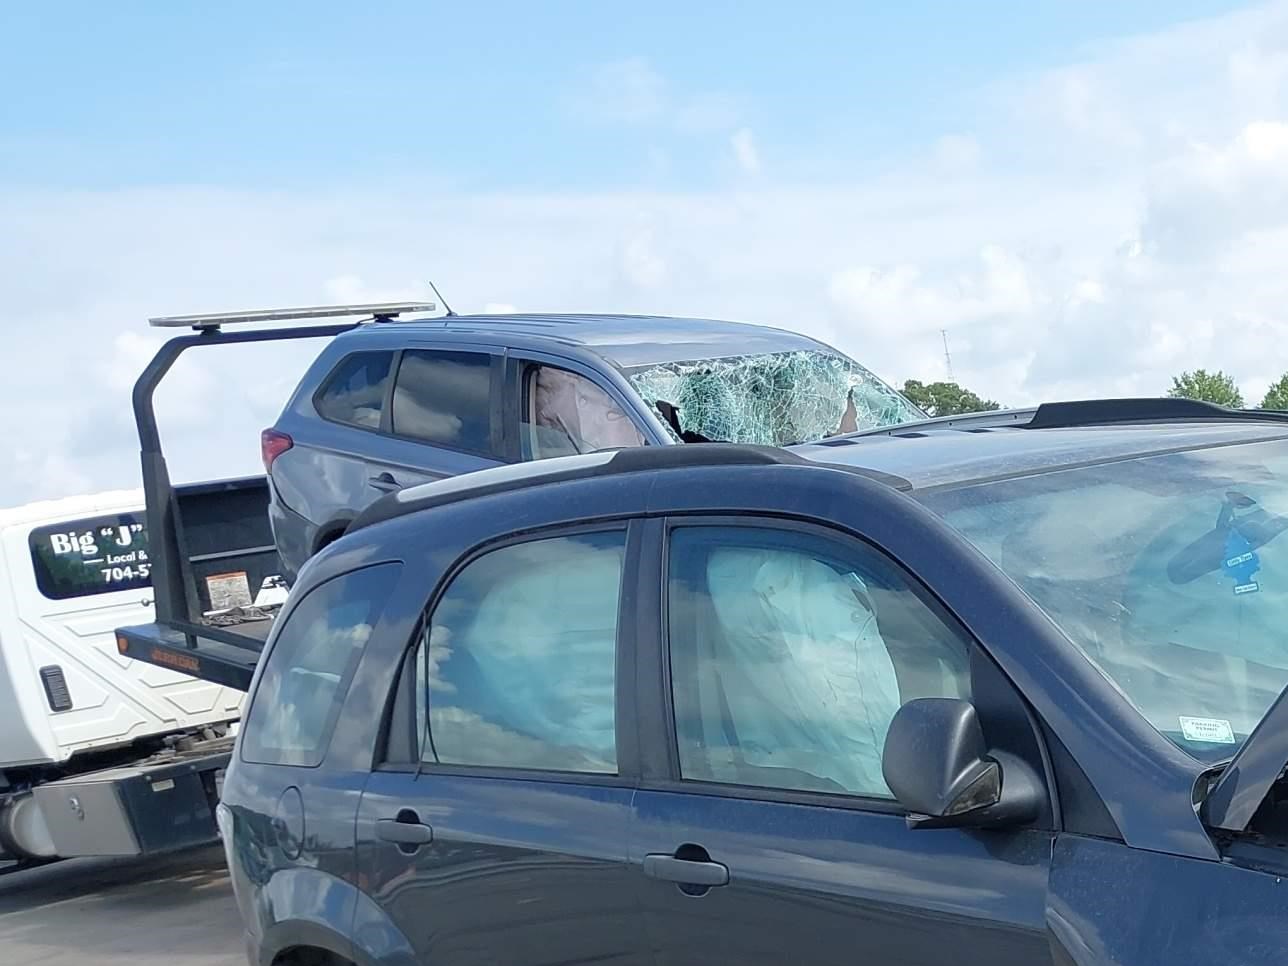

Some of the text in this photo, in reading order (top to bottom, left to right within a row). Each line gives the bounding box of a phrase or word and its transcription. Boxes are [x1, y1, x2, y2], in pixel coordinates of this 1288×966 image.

[50, 531, 98, 555] Big
[107, 551, 136, 564] Local
[101, 563, 152, 583] 704-5
